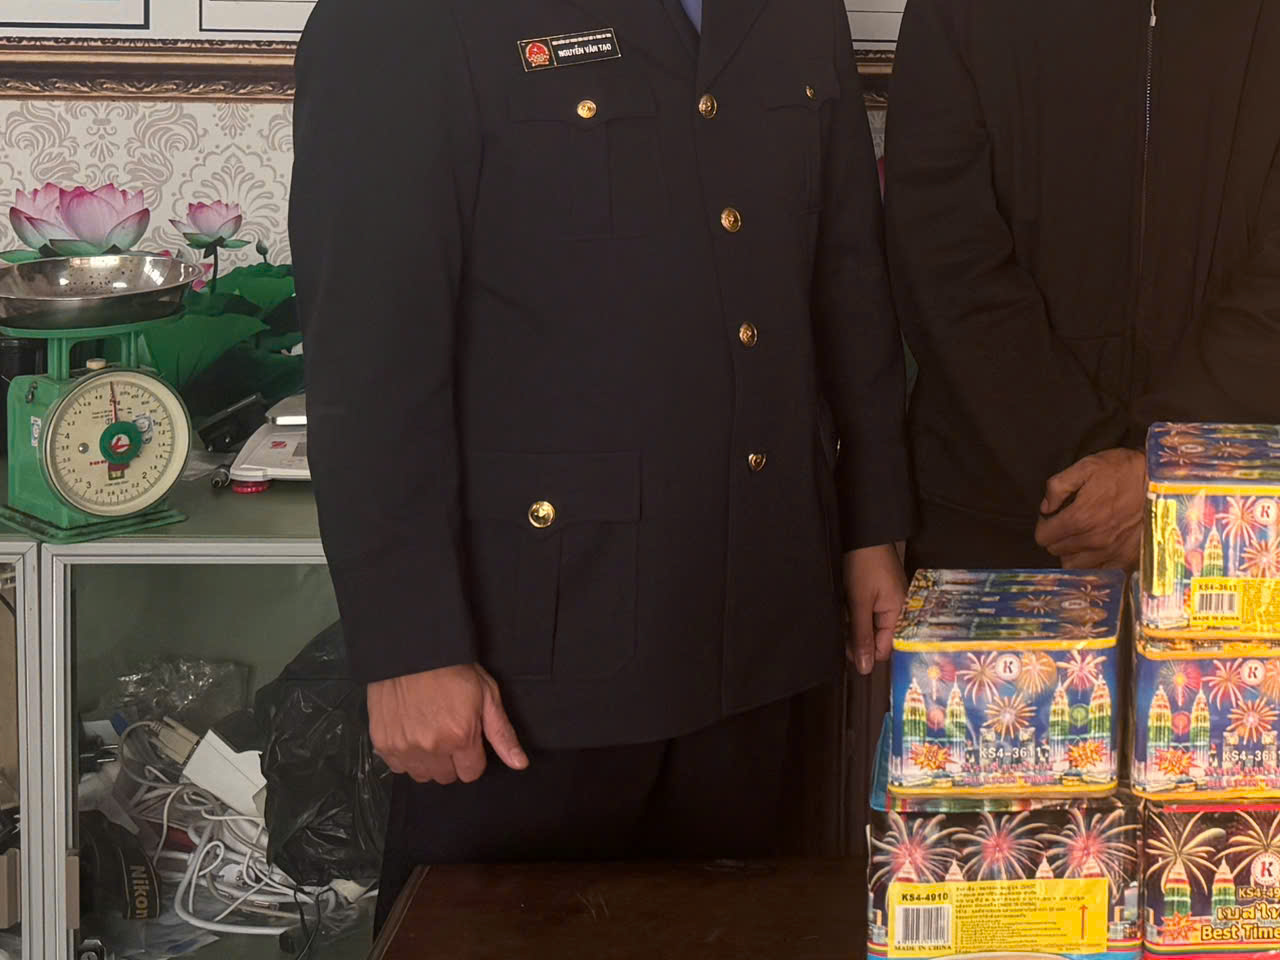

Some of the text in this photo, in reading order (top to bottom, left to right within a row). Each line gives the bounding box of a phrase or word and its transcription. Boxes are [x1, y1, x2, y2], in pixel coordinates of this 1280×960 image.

[558, 43, 612, 58] NGUYỄN VĂN TẠO
[1260, 505, 1271, 519] K
[1002, 661, 1014, 674] K
[1247, 665, 1258, 679] K
[901, 893, 948, 902] KS4-4910
[1201, 925, 1238, 940] Best
